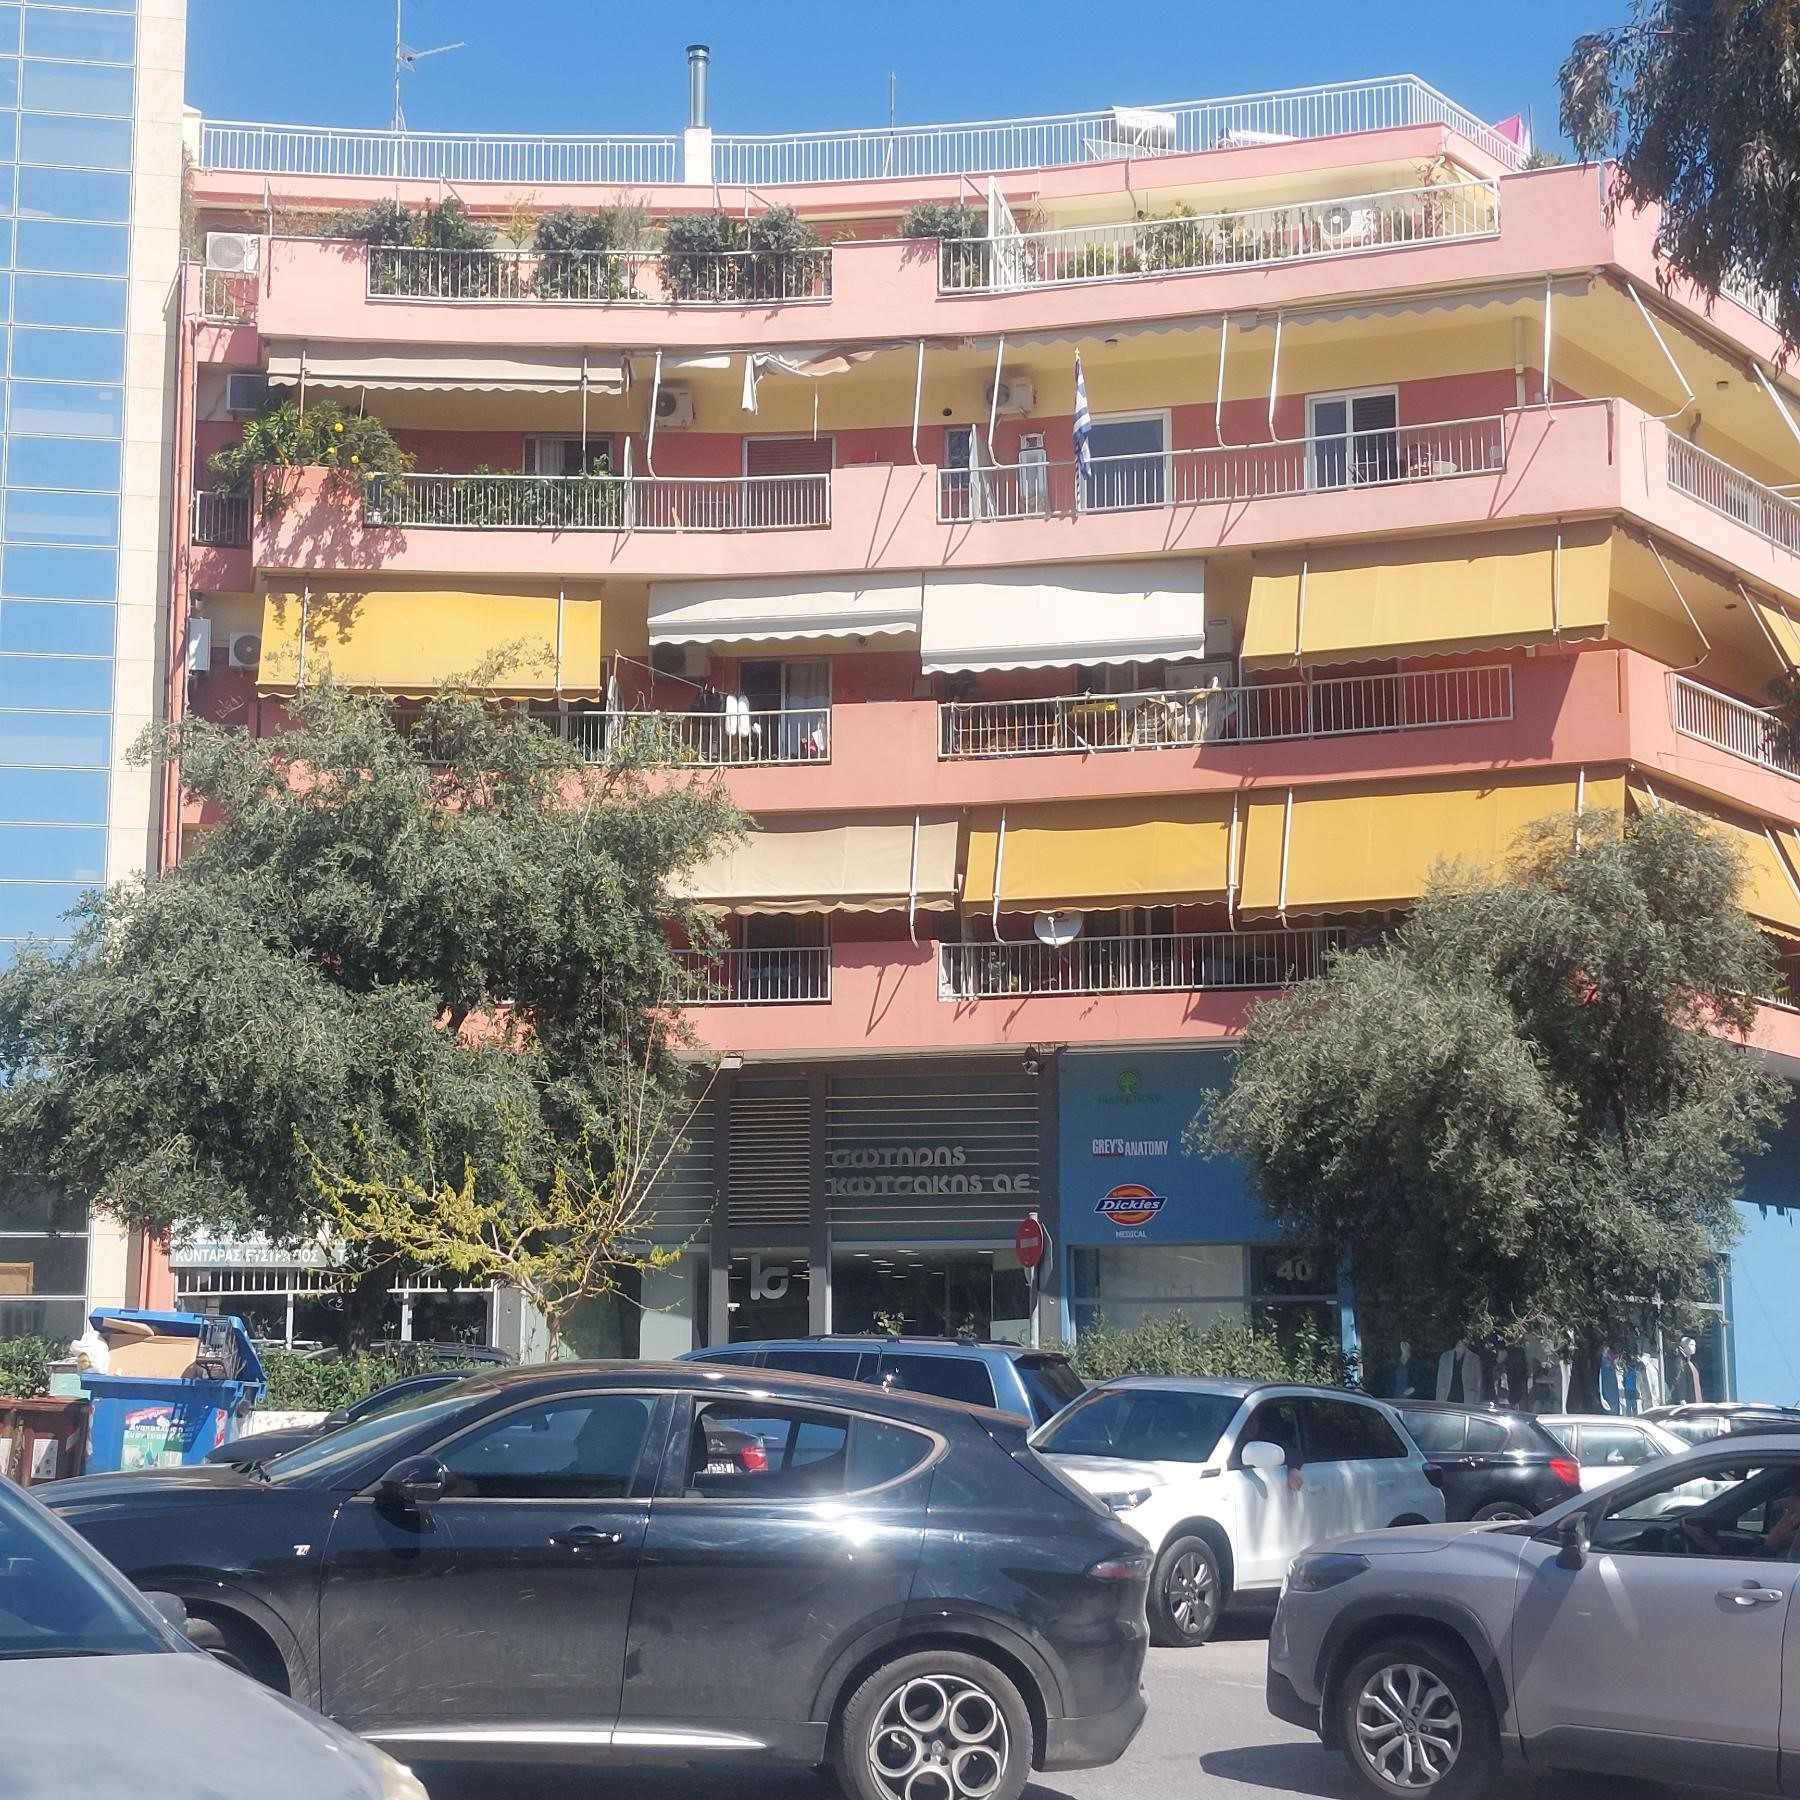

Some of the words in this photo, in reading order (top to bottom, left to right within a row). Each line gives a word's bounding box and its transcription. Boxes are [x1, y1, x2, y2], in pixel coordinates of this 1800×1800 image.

[1092, 1138, 1124, 1154] GREY'S
[1125, 1140, 1168, 1156] ANATOMY
[1100, 1199, 1160, 1212] Dickies
[1115, 1230, 1148, 1239] MEDICAL
[1276, 1260, 1312, 1281] 40
